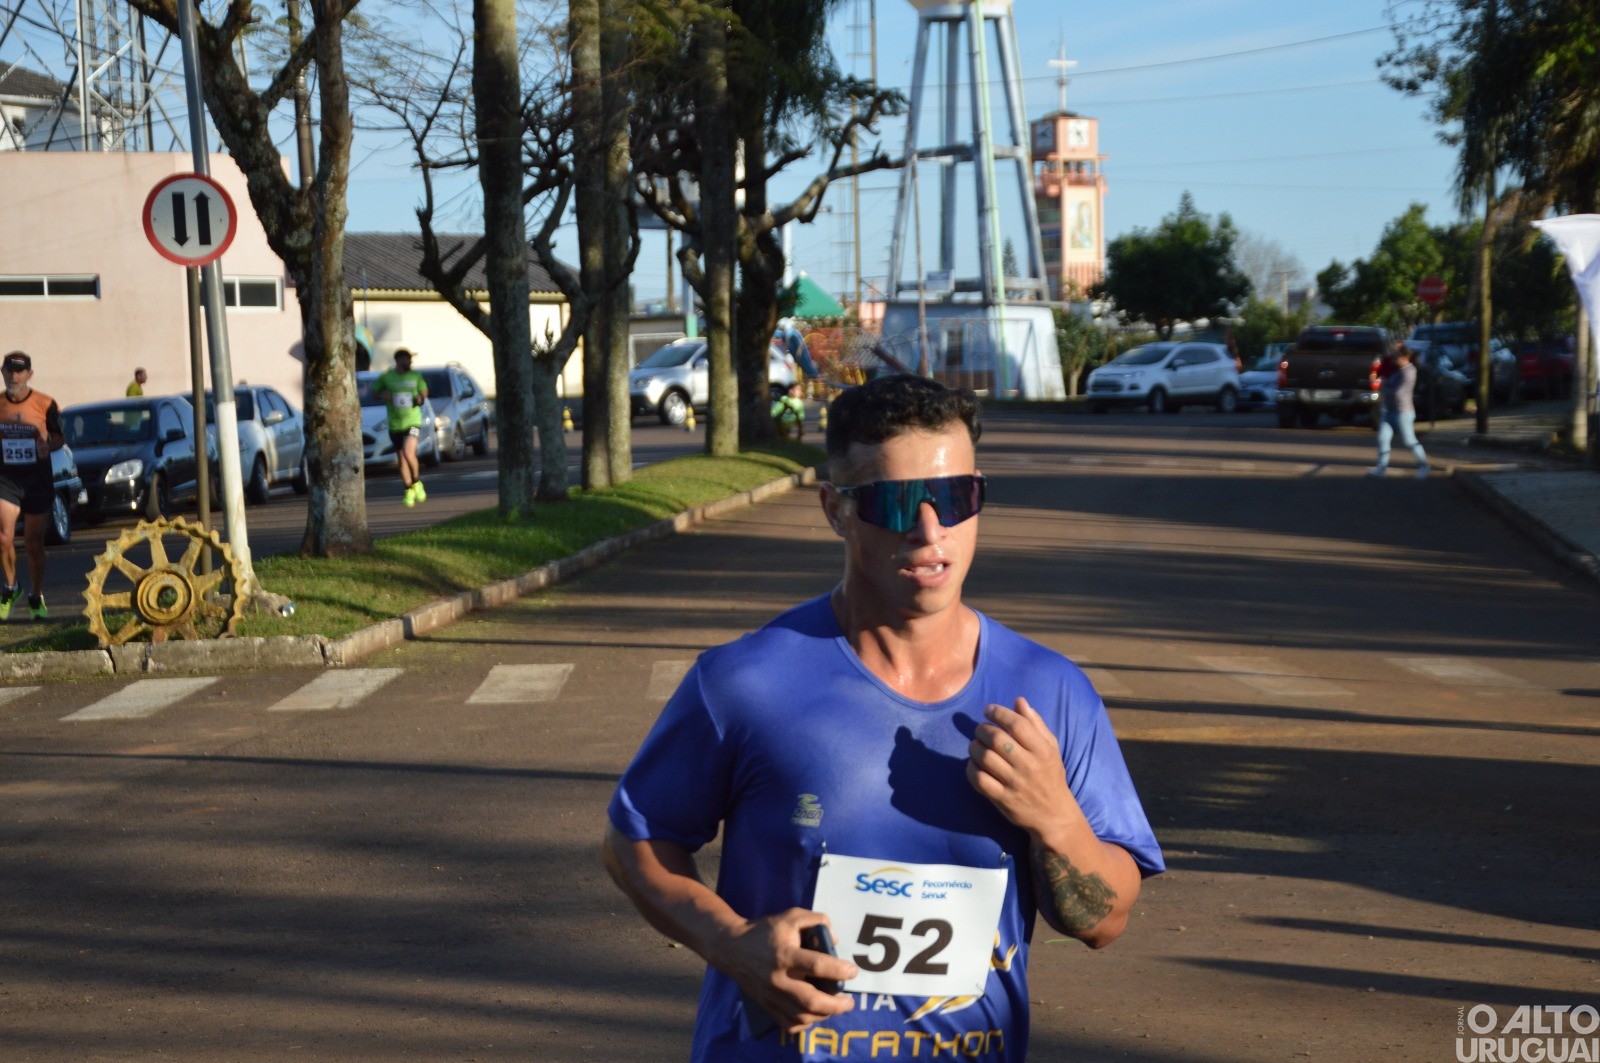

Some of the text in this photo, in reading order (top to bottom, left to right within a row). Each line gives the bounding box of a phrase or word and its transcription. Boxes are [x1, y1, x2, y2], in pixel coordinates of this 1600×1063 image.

[5, 447, 33, 460] 255
[855, 873, 914, 898] Sesc
[852, 912, 954, 976] 52
